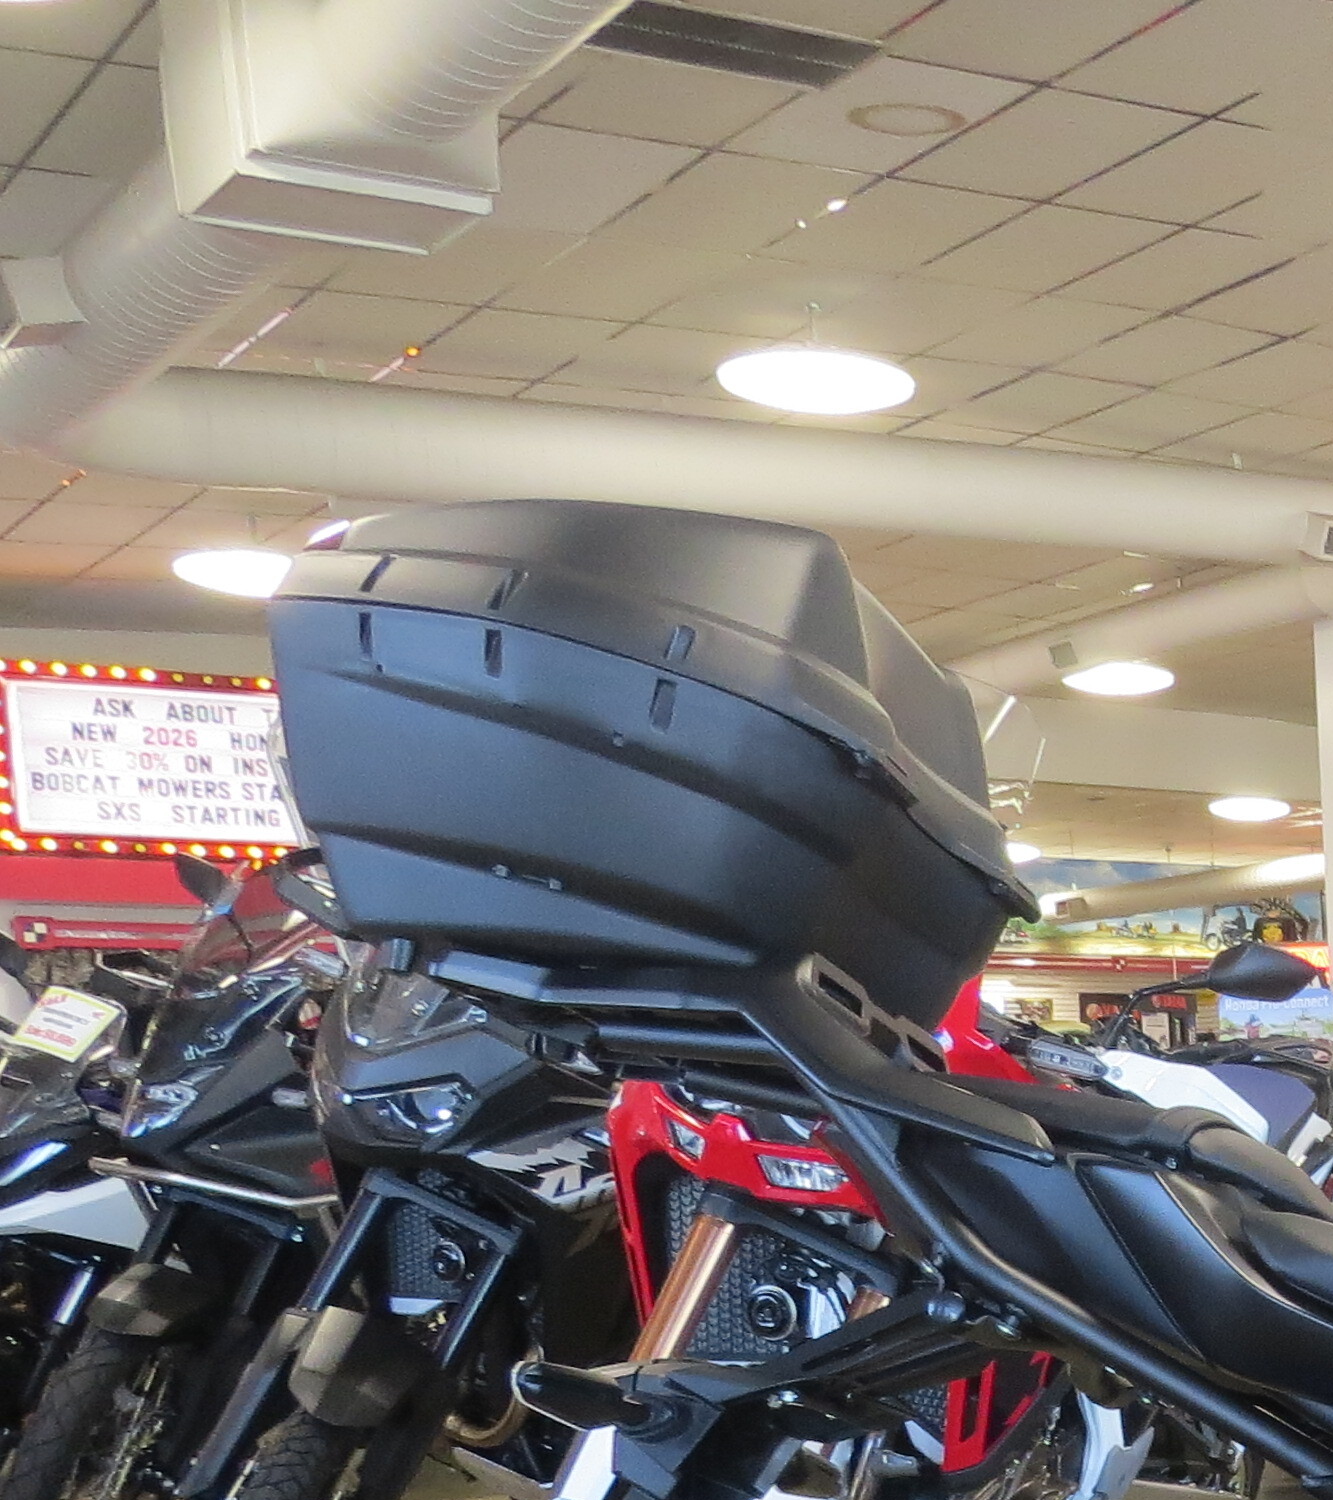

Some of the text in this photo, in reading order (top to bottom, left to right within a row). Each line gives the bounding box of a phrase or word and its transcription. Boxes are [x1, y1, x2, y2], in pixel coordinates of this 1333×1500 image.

[93, 697, 136, 719] ASK
[166, 702, 237, 725] ABOUT
[71, 722, 117, 743] NEW
[142, 726, 198, 748] 2026
[45, 747, 103, 768] SAVE
[185, 755, 213, 775] ON
[233, 757, 269, 777] INS
[32, 772, 283, 802] BOBCAT MOWERS STA
[97, 802, 281, 828] SXS STARTING
